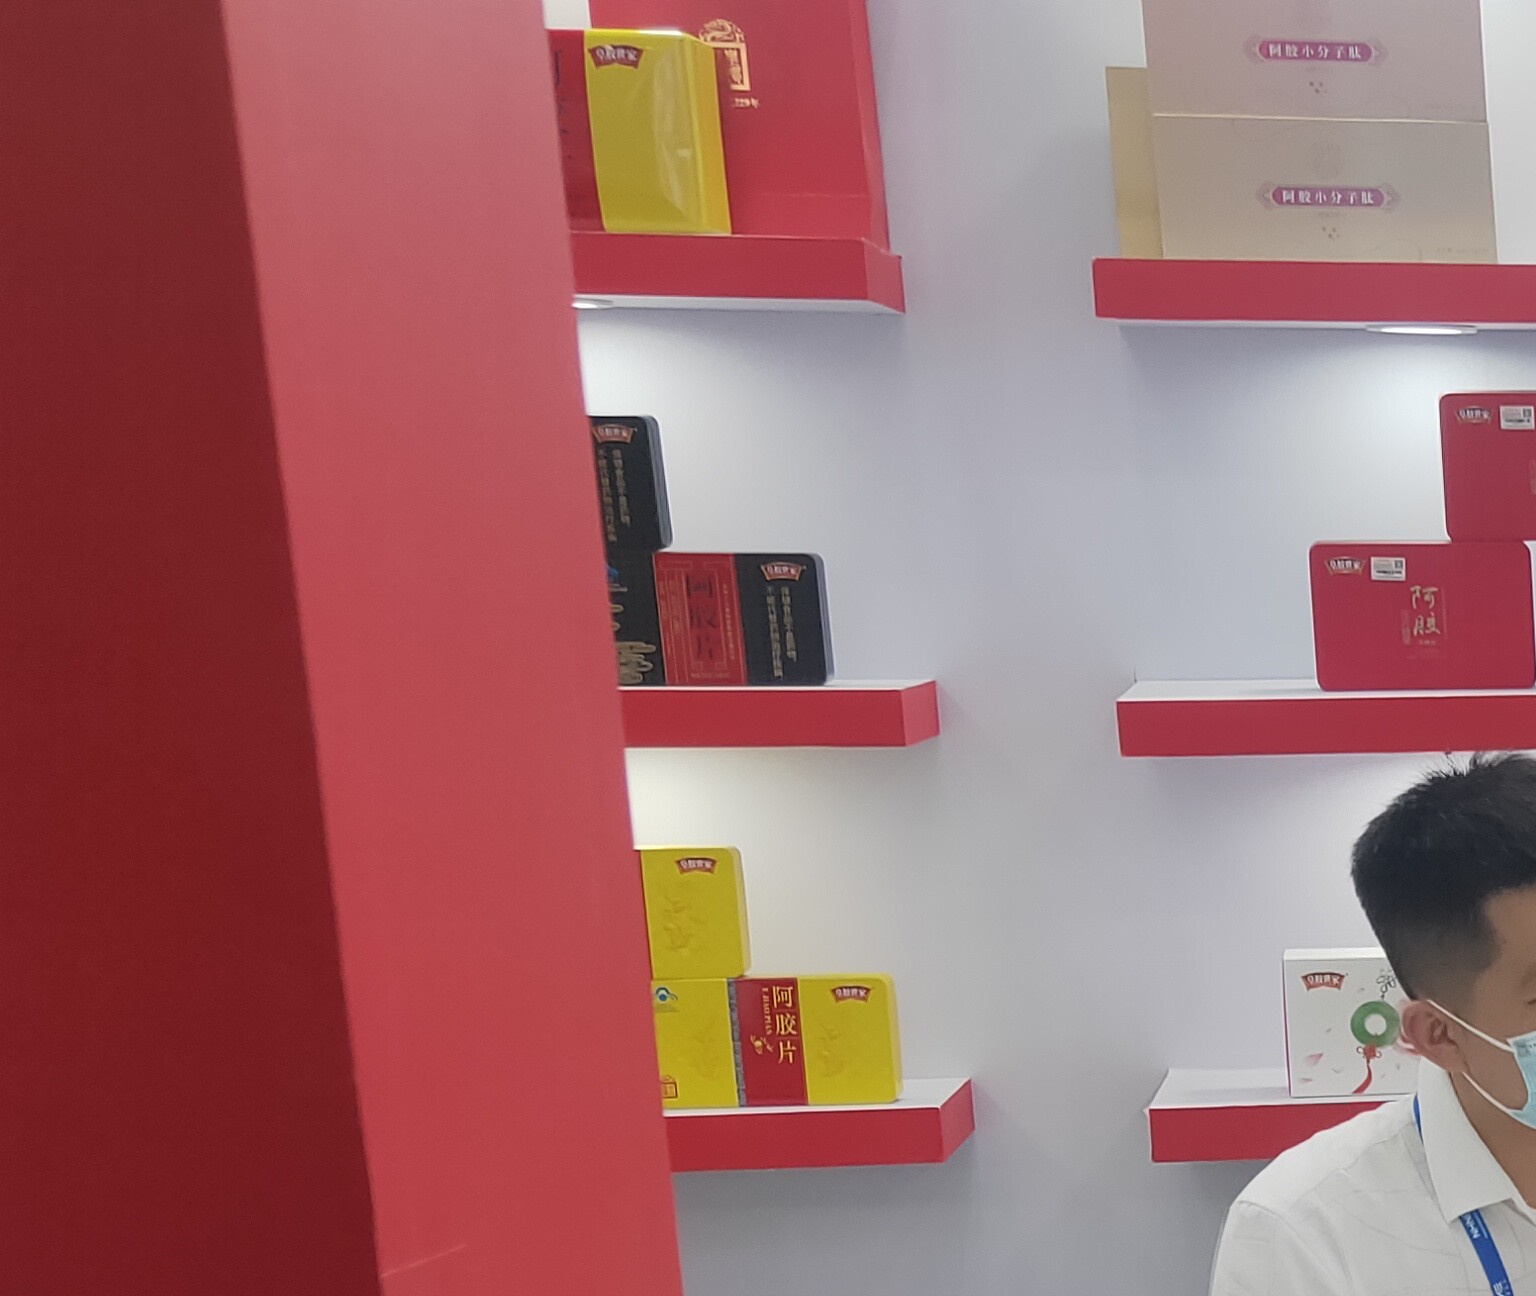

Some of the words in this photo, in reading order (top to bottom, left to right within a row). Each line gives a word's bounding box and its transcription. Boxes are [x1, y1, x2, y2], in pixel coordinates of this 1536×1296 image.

[1268, 44, 1361, 59] 阿胶小分子肽
[1282, 190, 1374, 205] 阿胶小分子肽
[772, 985, 798, 1064] 阿胶片
